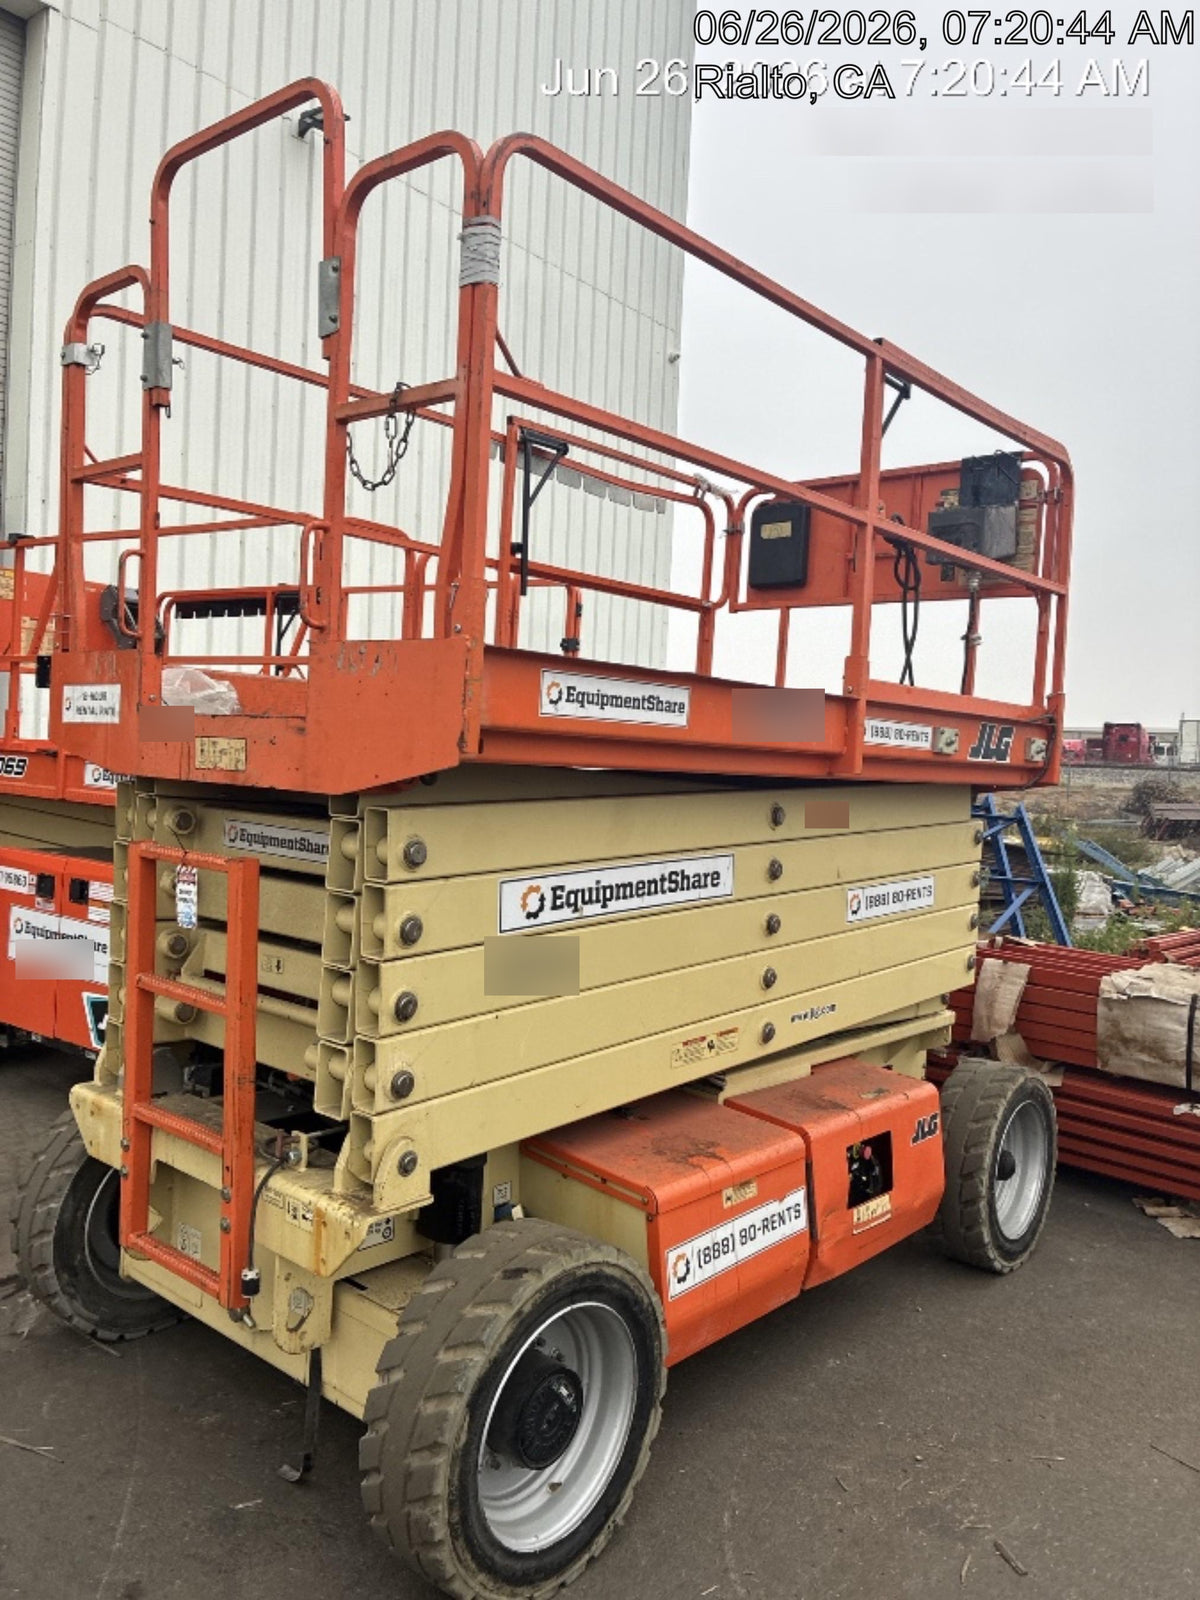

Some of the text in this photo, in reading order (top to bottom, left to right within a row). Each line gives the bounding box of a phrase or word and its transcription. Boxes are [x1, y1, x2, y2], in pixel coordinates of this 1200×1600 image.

[565, 685, 686, 714] EquipmentShare
[967, 721, 1016, 764] JLG
[549, 868, 721, 915] EquipmentShare
[910, 1111, 940, 1147] JLG
[696, 1203, 802, 1270] (888) 80-RENTS
